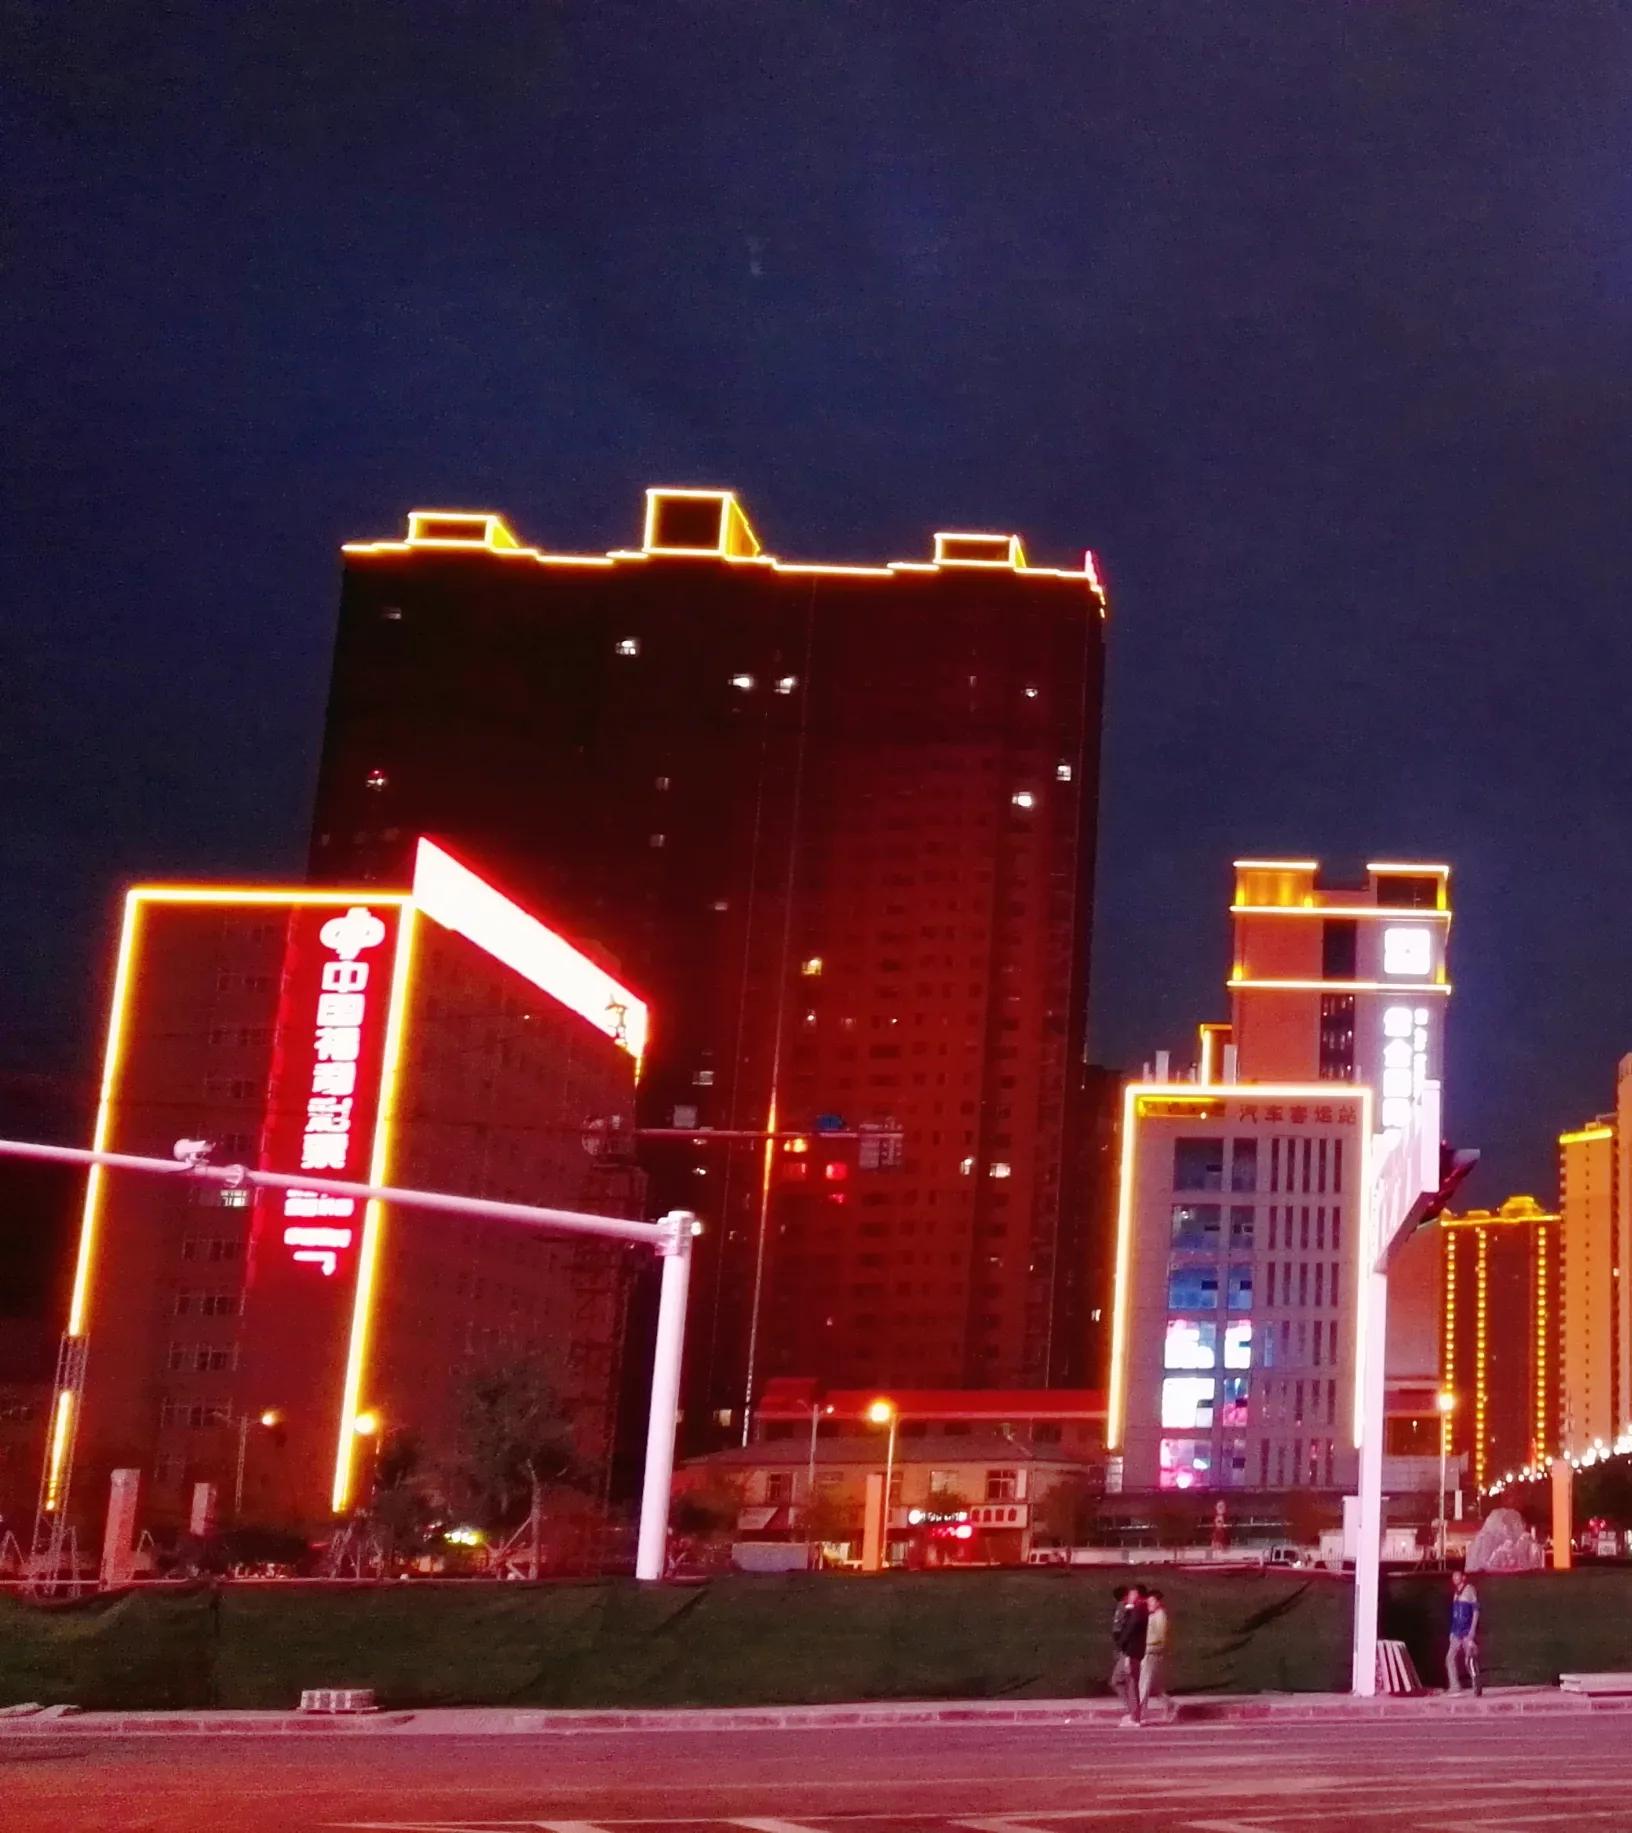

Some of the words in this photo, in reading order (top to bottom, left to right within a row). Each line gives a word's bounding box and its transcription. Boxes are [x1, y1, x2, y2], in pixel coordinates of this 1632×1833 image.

[1239, 1104, 1358, 1125] 汽车客运站
